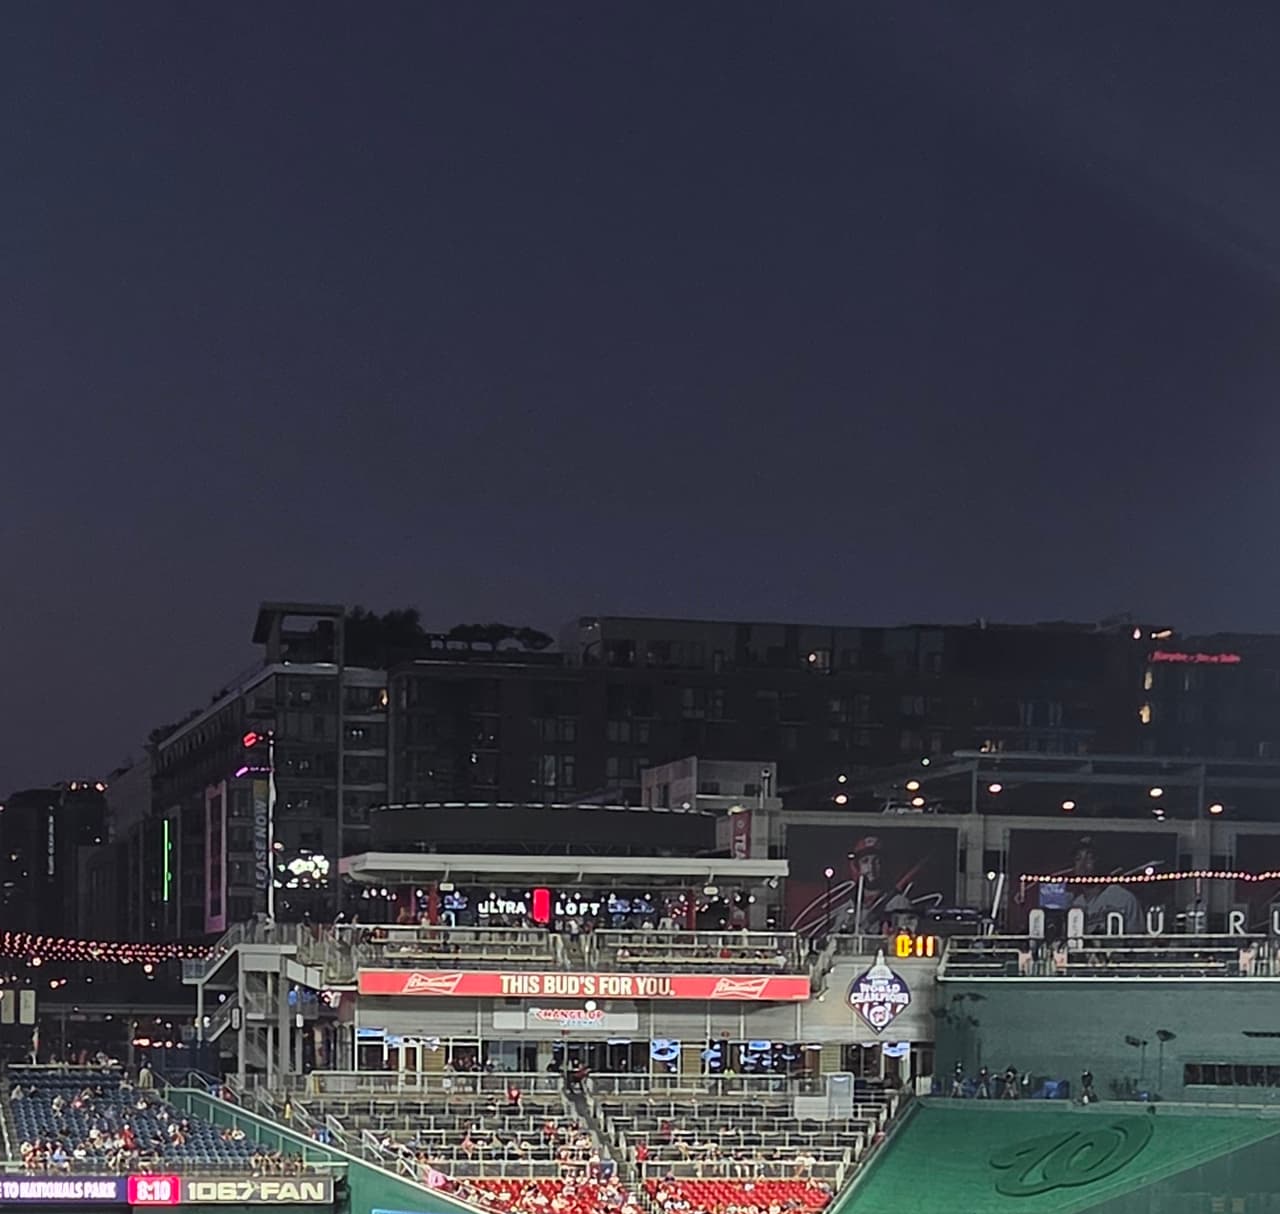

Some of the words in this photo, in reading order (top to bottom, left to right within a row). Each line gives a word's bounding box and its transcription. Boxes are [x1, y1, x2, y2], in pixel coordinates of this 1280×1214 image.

[478, 900, 526, 914] ULTRA
[555, 902, 600, 916] LOFT
[896, 934, 934, 957] 0:11
[500, 975, 540, 994] THIS
[544, 975, 595, 995] BUD'S
[599, 976, 631, 995] FOR
[633, 976, 675, 996] YOU.
[860, 983, 900, 993] WORLD
[3, 1182, 18, 1199] TO
[20, 1182, 83, 1199] NATIONALS
[84, 1182, 117, 1199] PARK
[136, 1180, 170, 1200] 8:10
[261, 1182, 324, 1200] FAN
